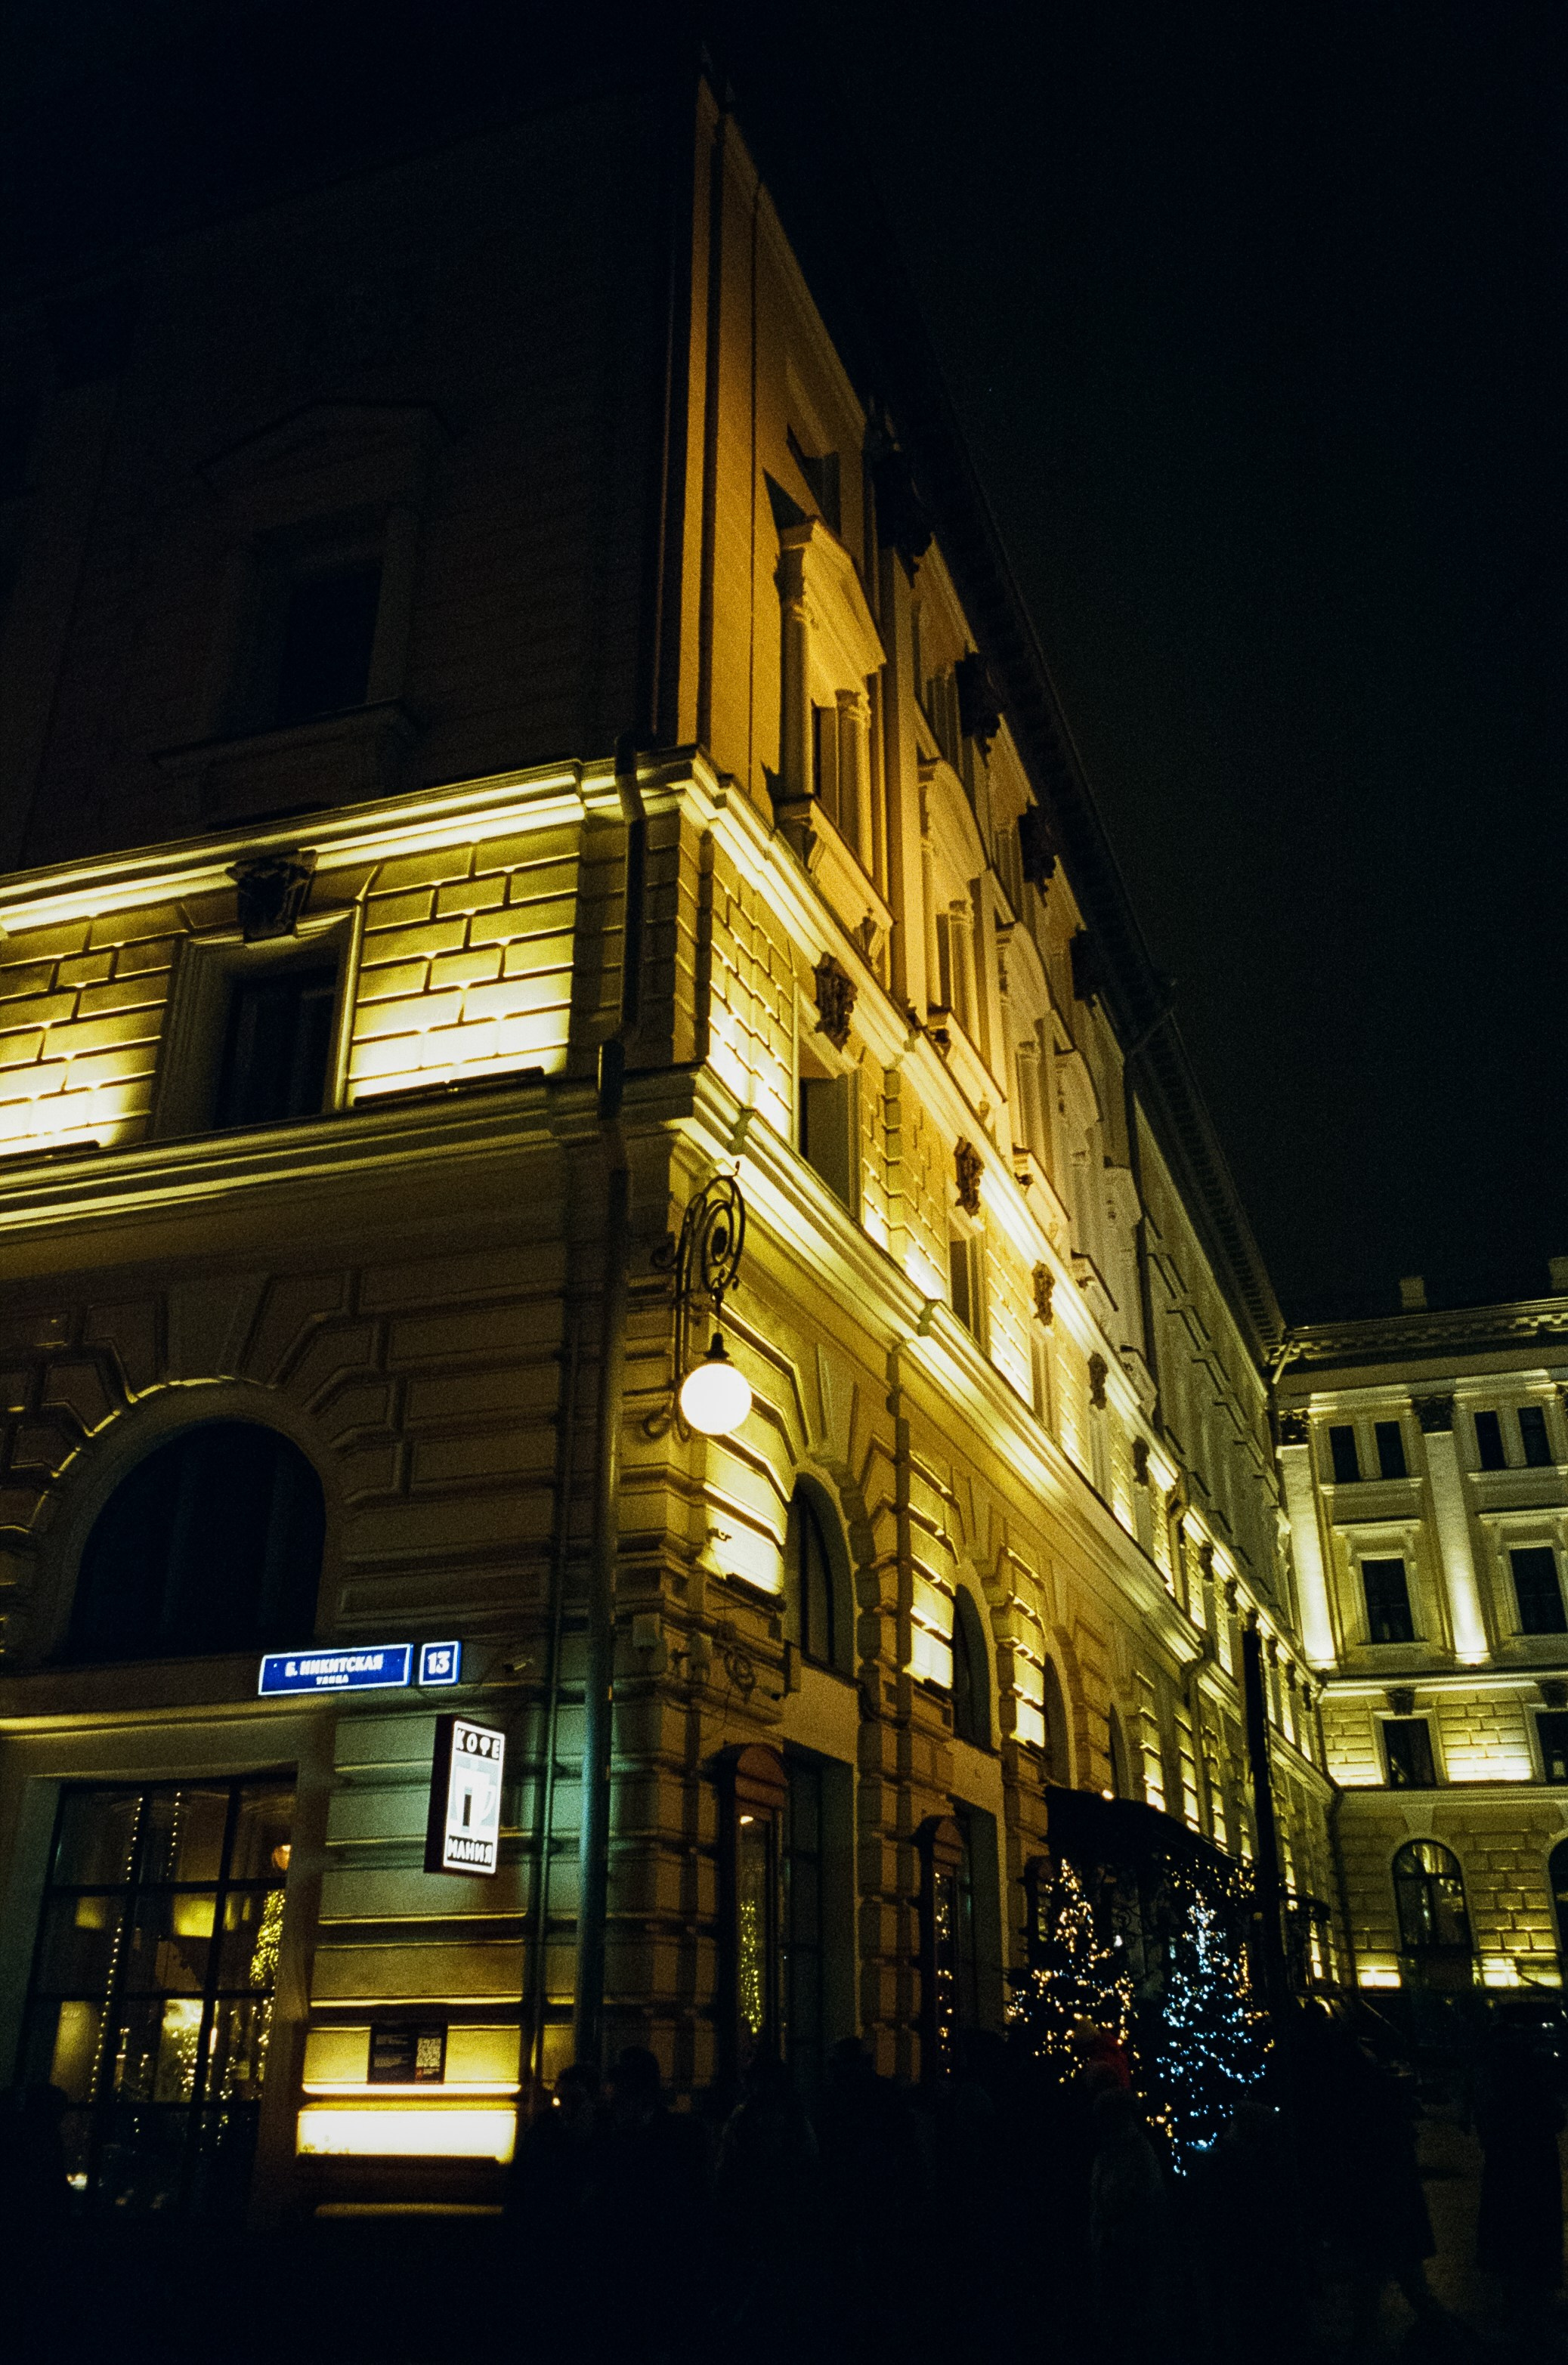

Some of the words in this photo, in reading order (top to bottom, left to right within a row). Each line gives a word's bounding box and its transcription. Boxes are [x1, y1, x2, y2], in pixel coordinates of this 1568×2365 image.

[285, 1662, 298, 1677] Б.
[300, 1653, 384, 1675] НИКИТСКАЯ
[428, 1650, 450, 1674] 13
[456, 1728, 500, 1759] КОФЕ
[447, 1838, 493, 1863] МАНИЯ
